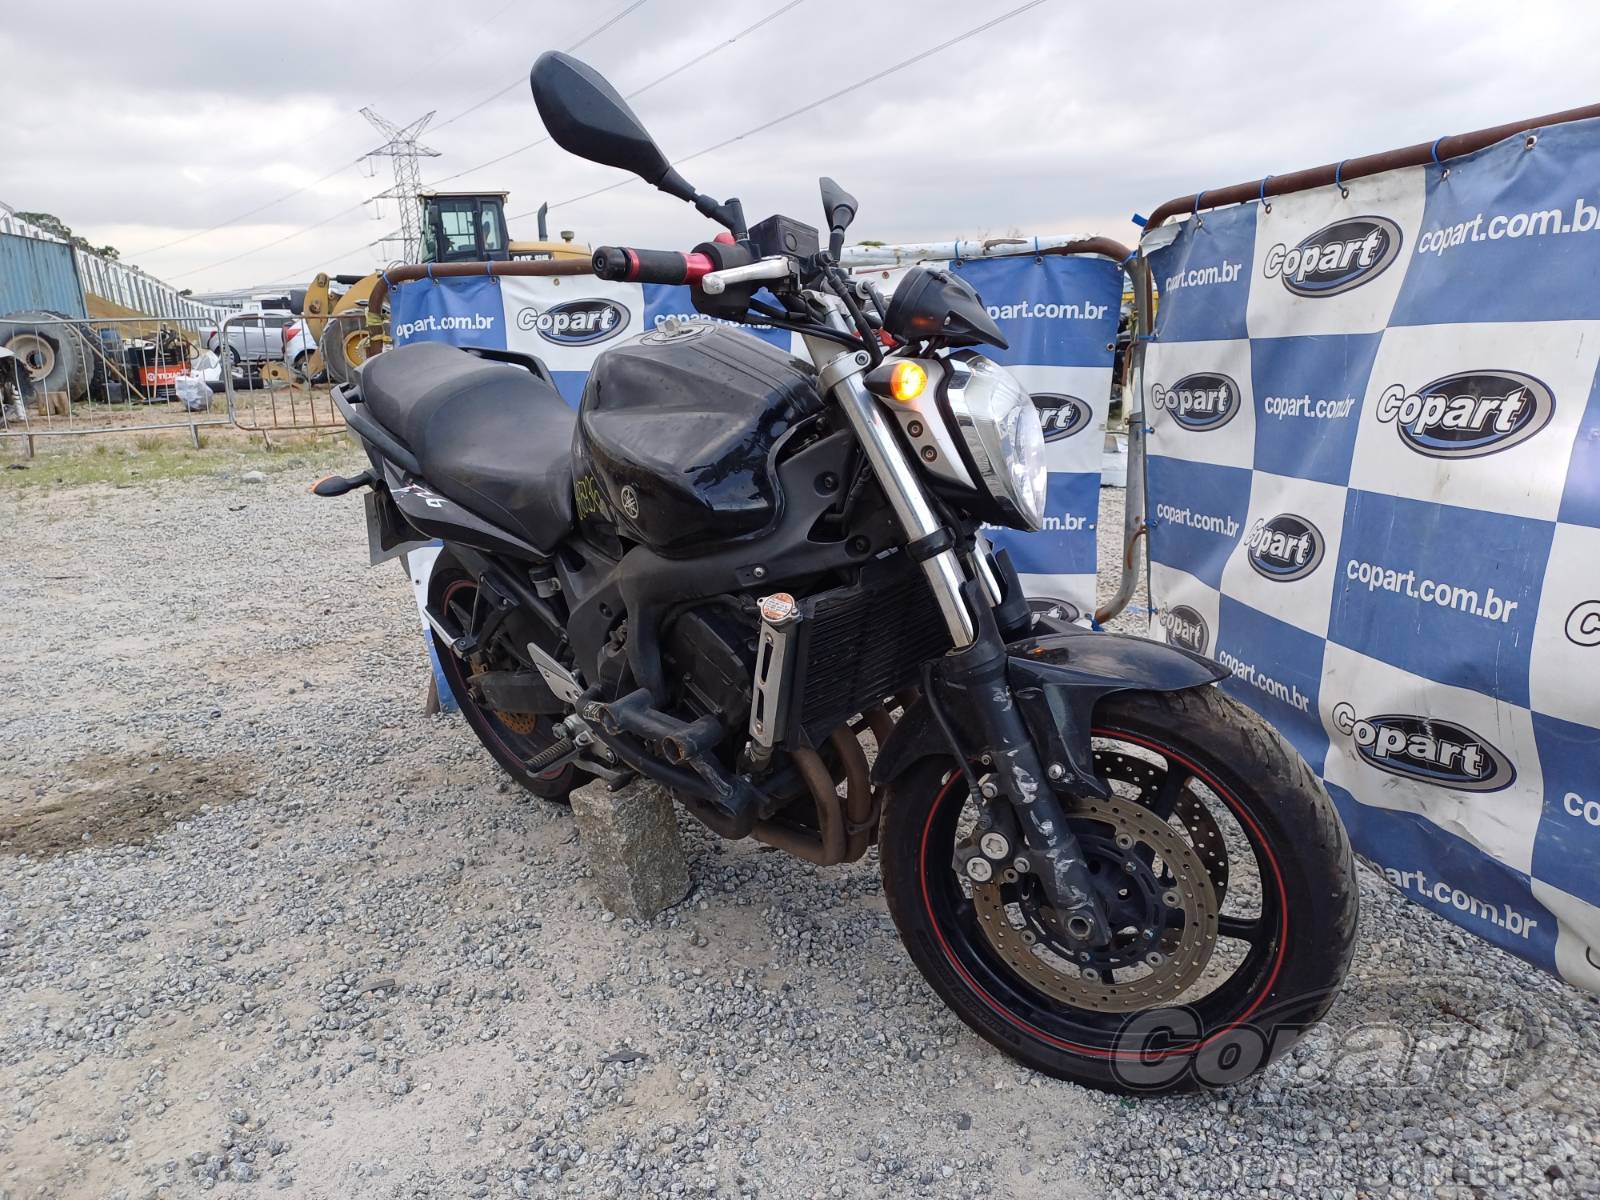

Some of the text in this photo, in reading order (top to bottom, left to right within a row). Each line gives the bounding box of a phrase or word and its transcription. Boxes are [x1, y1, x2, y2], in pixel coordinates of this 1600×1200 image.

[1264, 226, 1383, 284] Copart
[396, 312, 495, 339] opart.com.br
[517, 305, 616, 336] Copart
[986, 301, 1108, 320] part.com.br
[1151, 382, 1230, 416] Copart
[1376, 384, 1528, 436] Copart
[1157, 503, 1240, 538] copart.com.br
[1244, 517, 1312, 567] Copart
[1346, 559, 1518, 623] copart.com.br
[1219, 650, 1310, 713] copart.com.br
[1332, 701, 1484, 778] Copart
[1384, 866, 1538, 940] art.com.br
